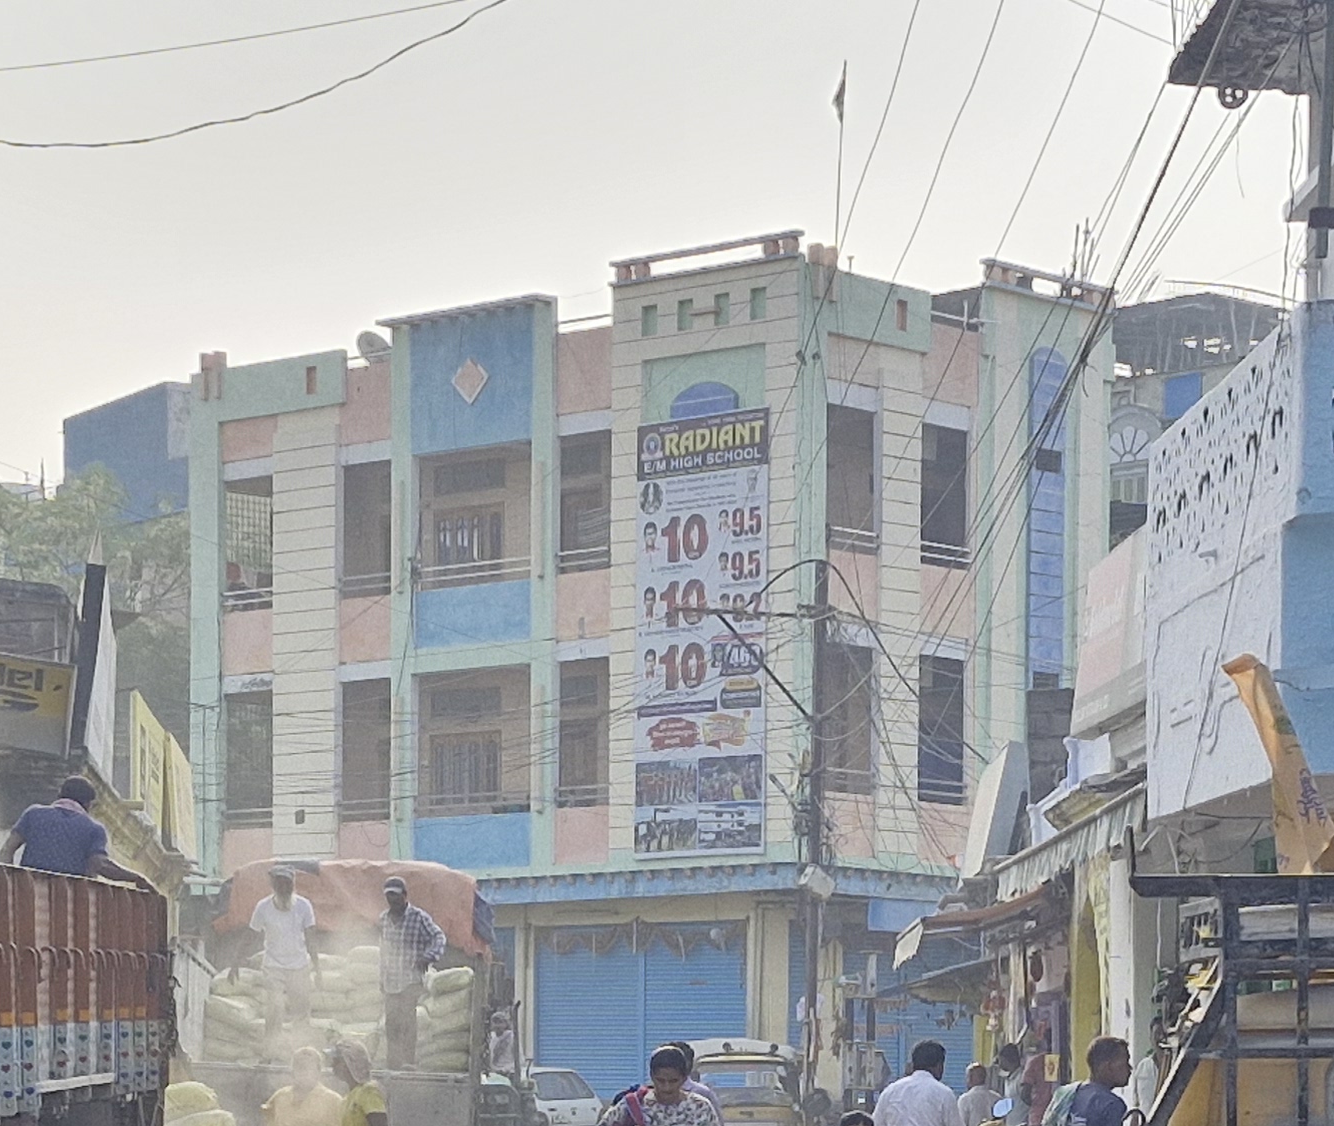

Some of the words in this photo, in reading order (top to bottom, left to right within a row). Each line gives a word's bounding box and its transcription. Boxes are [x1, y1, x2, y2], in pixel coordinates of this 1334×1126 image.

[663, 420, 765, 457] RADIANT
[669, 455, 703, 471] HIGH
[706, 446, 762, 465] SCHOOL
[661, 513, 709, 564] 10
[730, 506, 762, 538] 9.5
[730, 550, 762, 582] 9.5
[659, 642, 708, 691] 10
